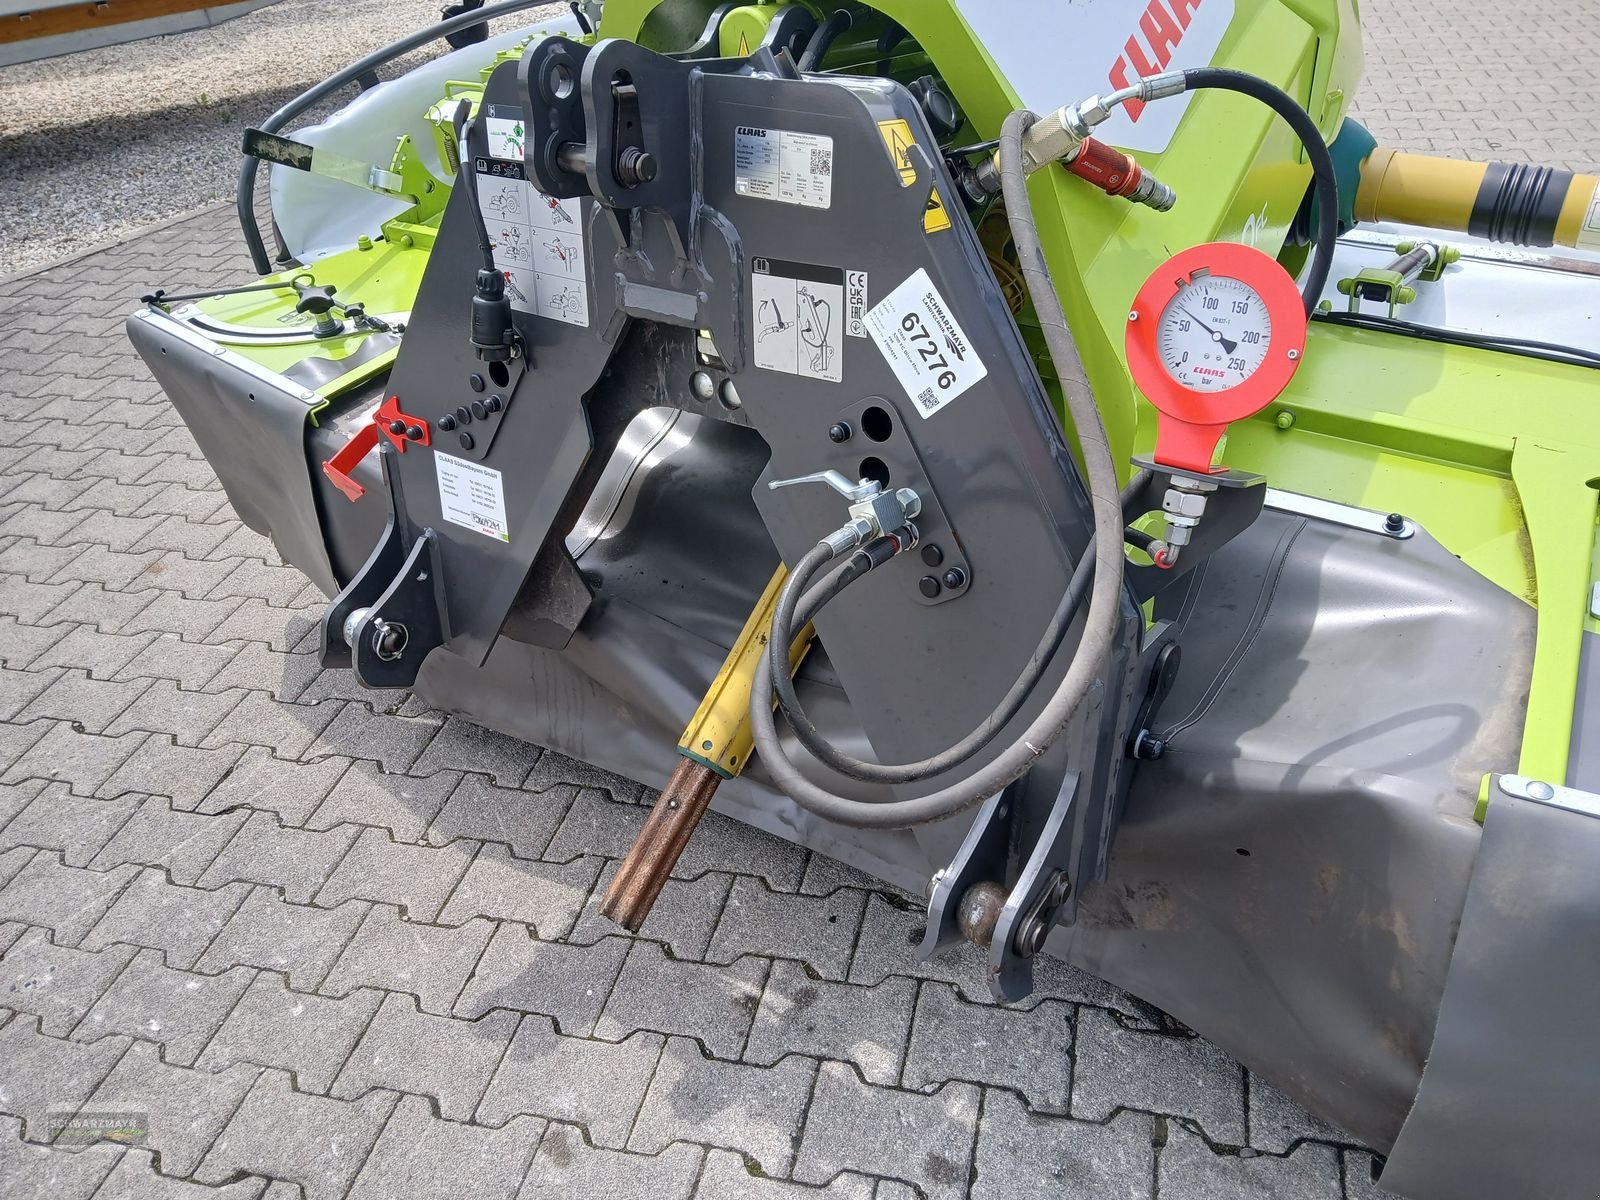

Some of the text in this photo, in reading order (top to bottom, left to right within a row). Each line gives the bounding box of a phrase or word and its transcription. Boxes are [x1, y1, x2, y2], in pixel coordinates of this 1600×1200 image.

[737, 127, 767, 138] CLAAS
[1202, 296, 1219, 310] 100
[1231, 301, 1248, 314] 150
[922, 298, 945, 333] LANDTECHNIK
[926, 292, 966, 353] SCHWARZMAYR
[1178, 320, 1190, 332] 50
[1241, 331, 1260, 344] 200
[902, 312, 956, 390] 67276
[1182, 351, 1188, 363] 0
[1227, 358, 1246, 371] 250
[1193, 366, 1225, 378] CLAAS
[1201, 377, 1212, 385] bar
[439, 455, 453, 464] CLAAS
